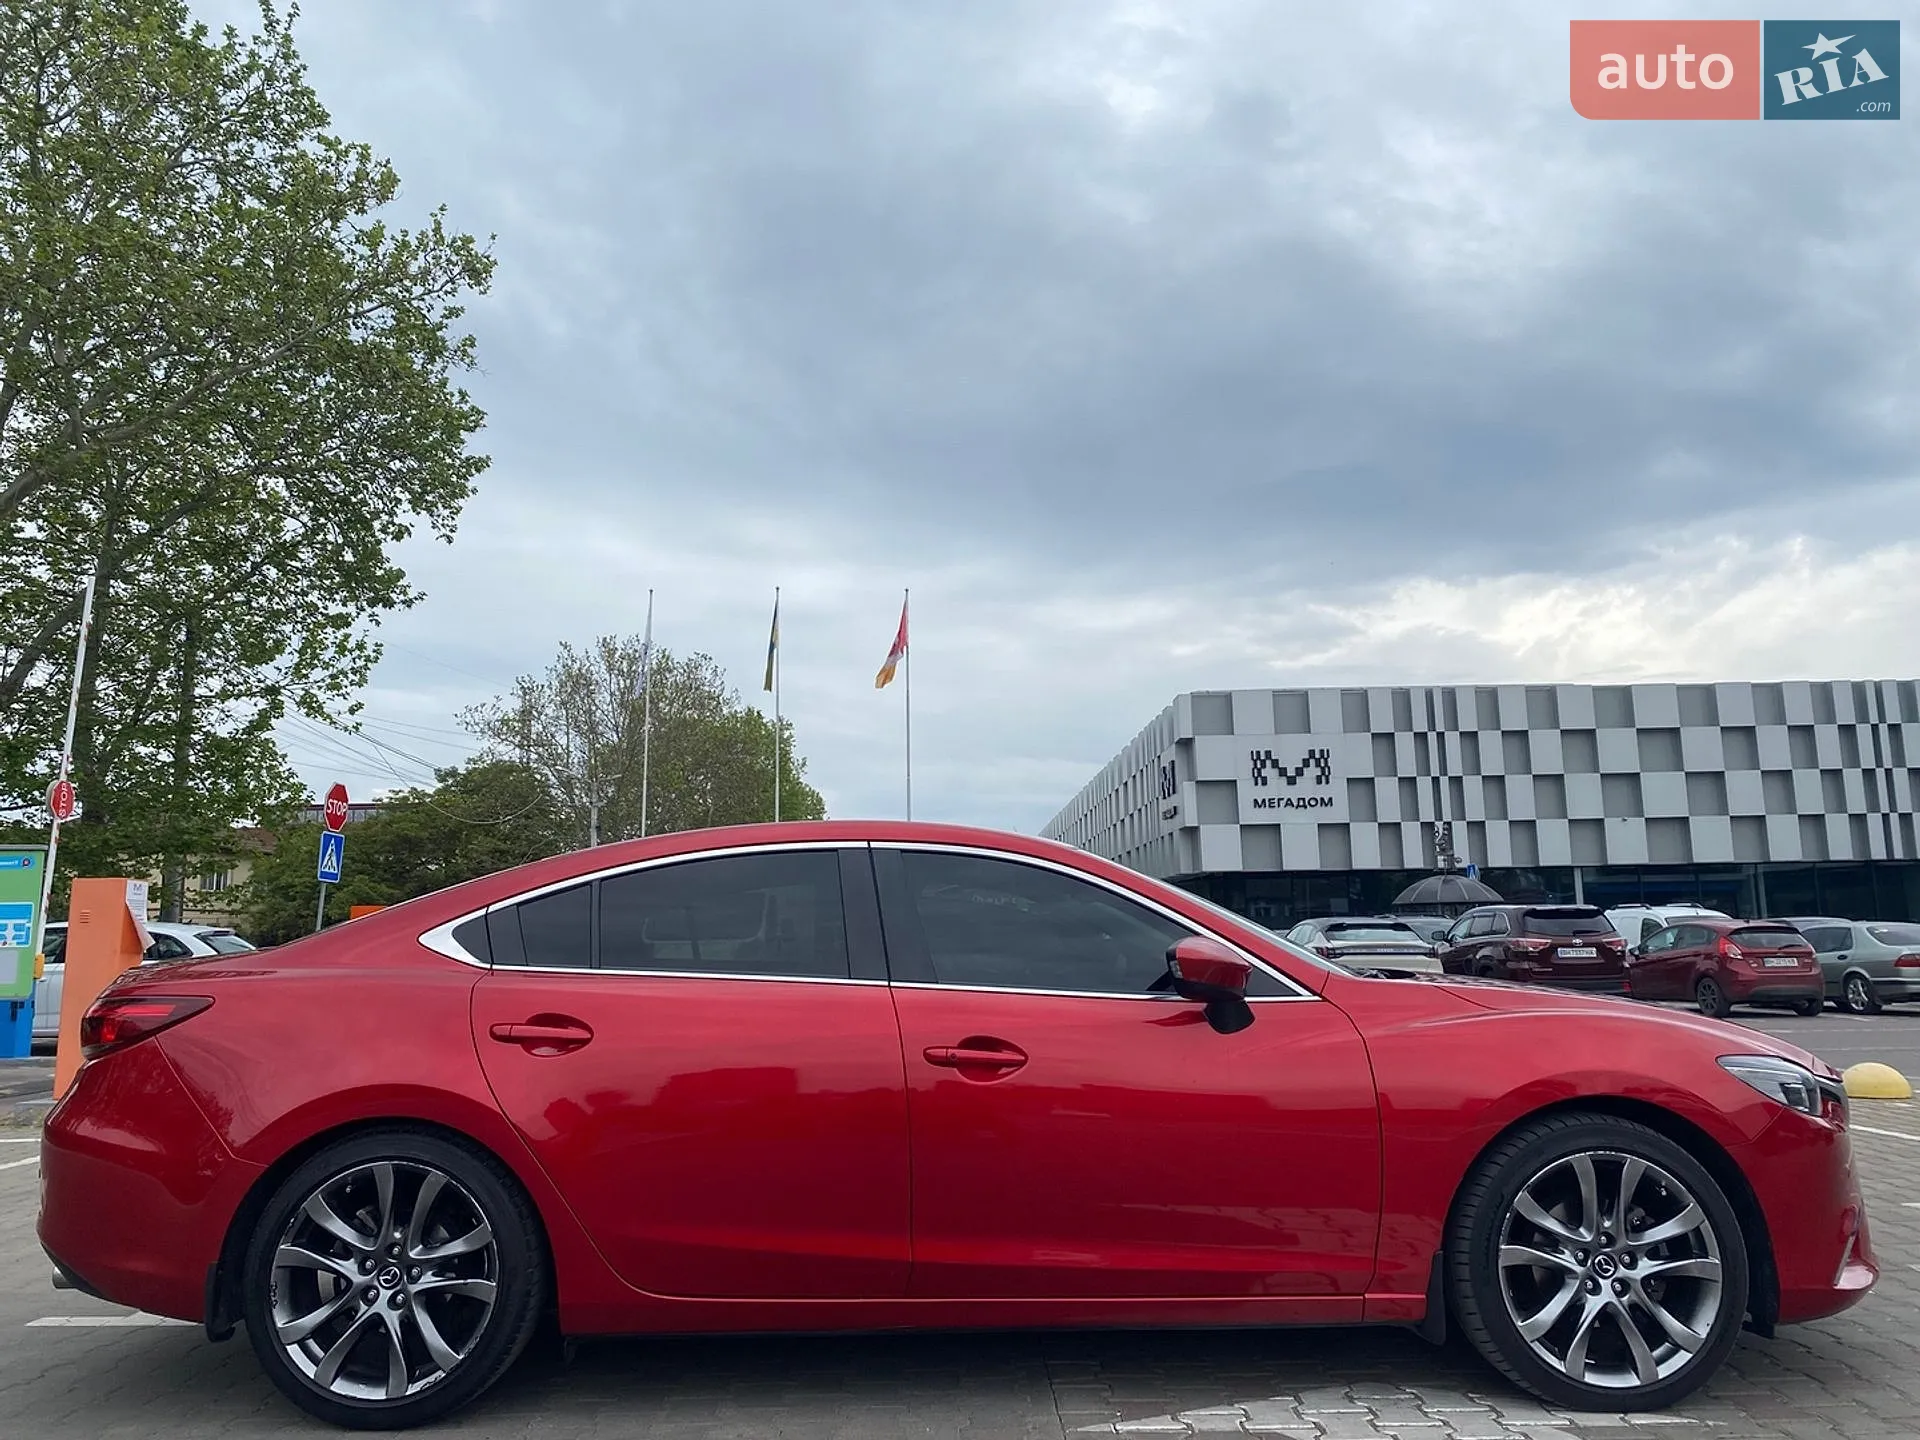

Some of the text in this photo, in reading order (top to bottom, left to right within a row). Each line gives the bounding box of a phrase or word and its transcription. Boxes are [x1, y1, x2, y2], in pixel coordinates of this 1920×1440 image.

[58, 783, 68, 818] STOP
[327, 799, 348, 816] STOP
[1253, 796, 1333, 809] МЕГАДОМ
